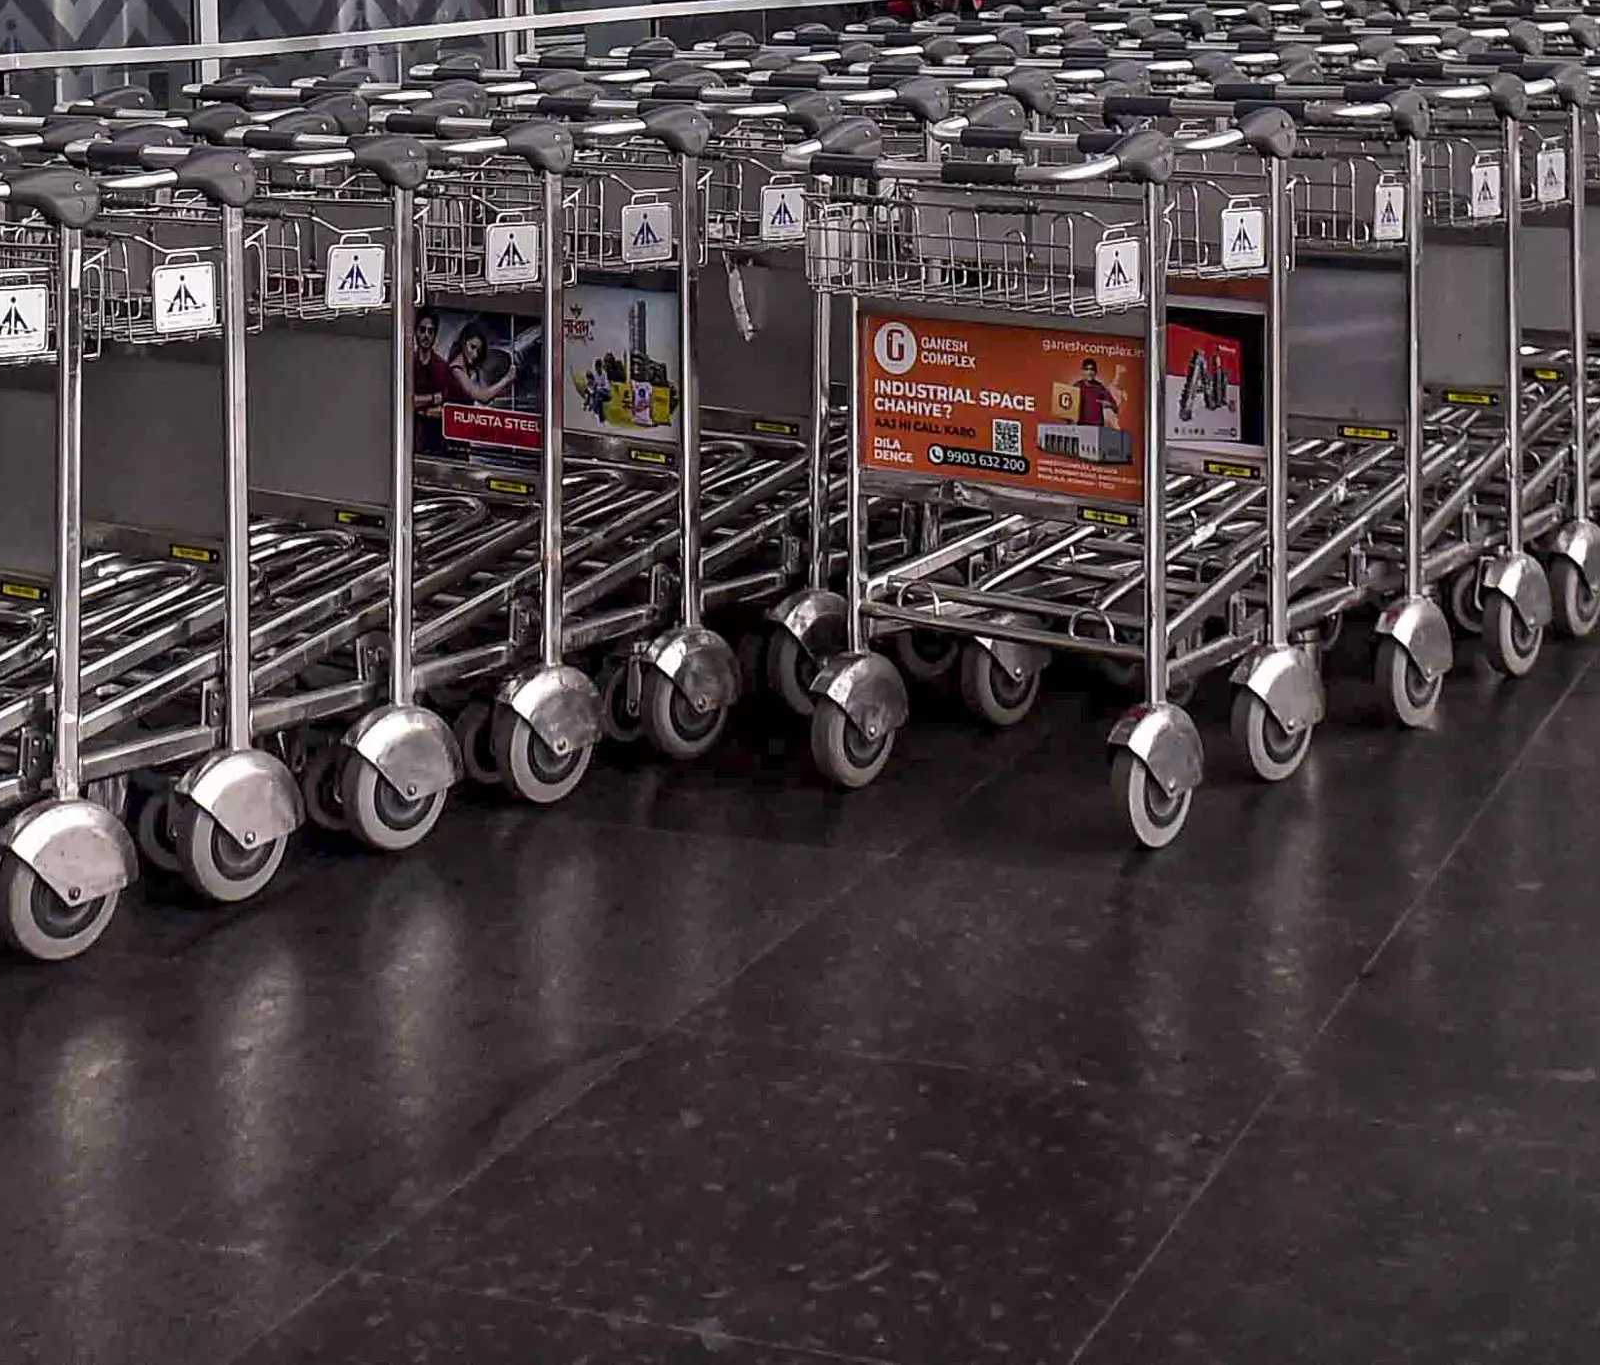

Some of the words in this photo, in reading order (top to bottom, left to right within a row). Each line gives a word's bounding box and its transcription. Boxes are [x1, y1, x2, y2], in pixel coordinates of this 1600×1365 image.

[921, 337, 968, 353] GANESH
[921, 352, 976, 368] COMPLEX
[874, 379, 976, 405] INDUSTRIAL
[979, 391, 1035, 412] SPACE
[874, 397, 952, 418] CHAHIYE?
[453, 411, 502, 427] RUNGTA
[913, 422, 941, 434] CALL
[874, 437, 901, 450] DILA
[874, 449, 914, 463] DENGE
[946, 450, 977, 465] 9903
[979, 453, 1000, 467] 632
[1003, 456, 1026, 472] 200
